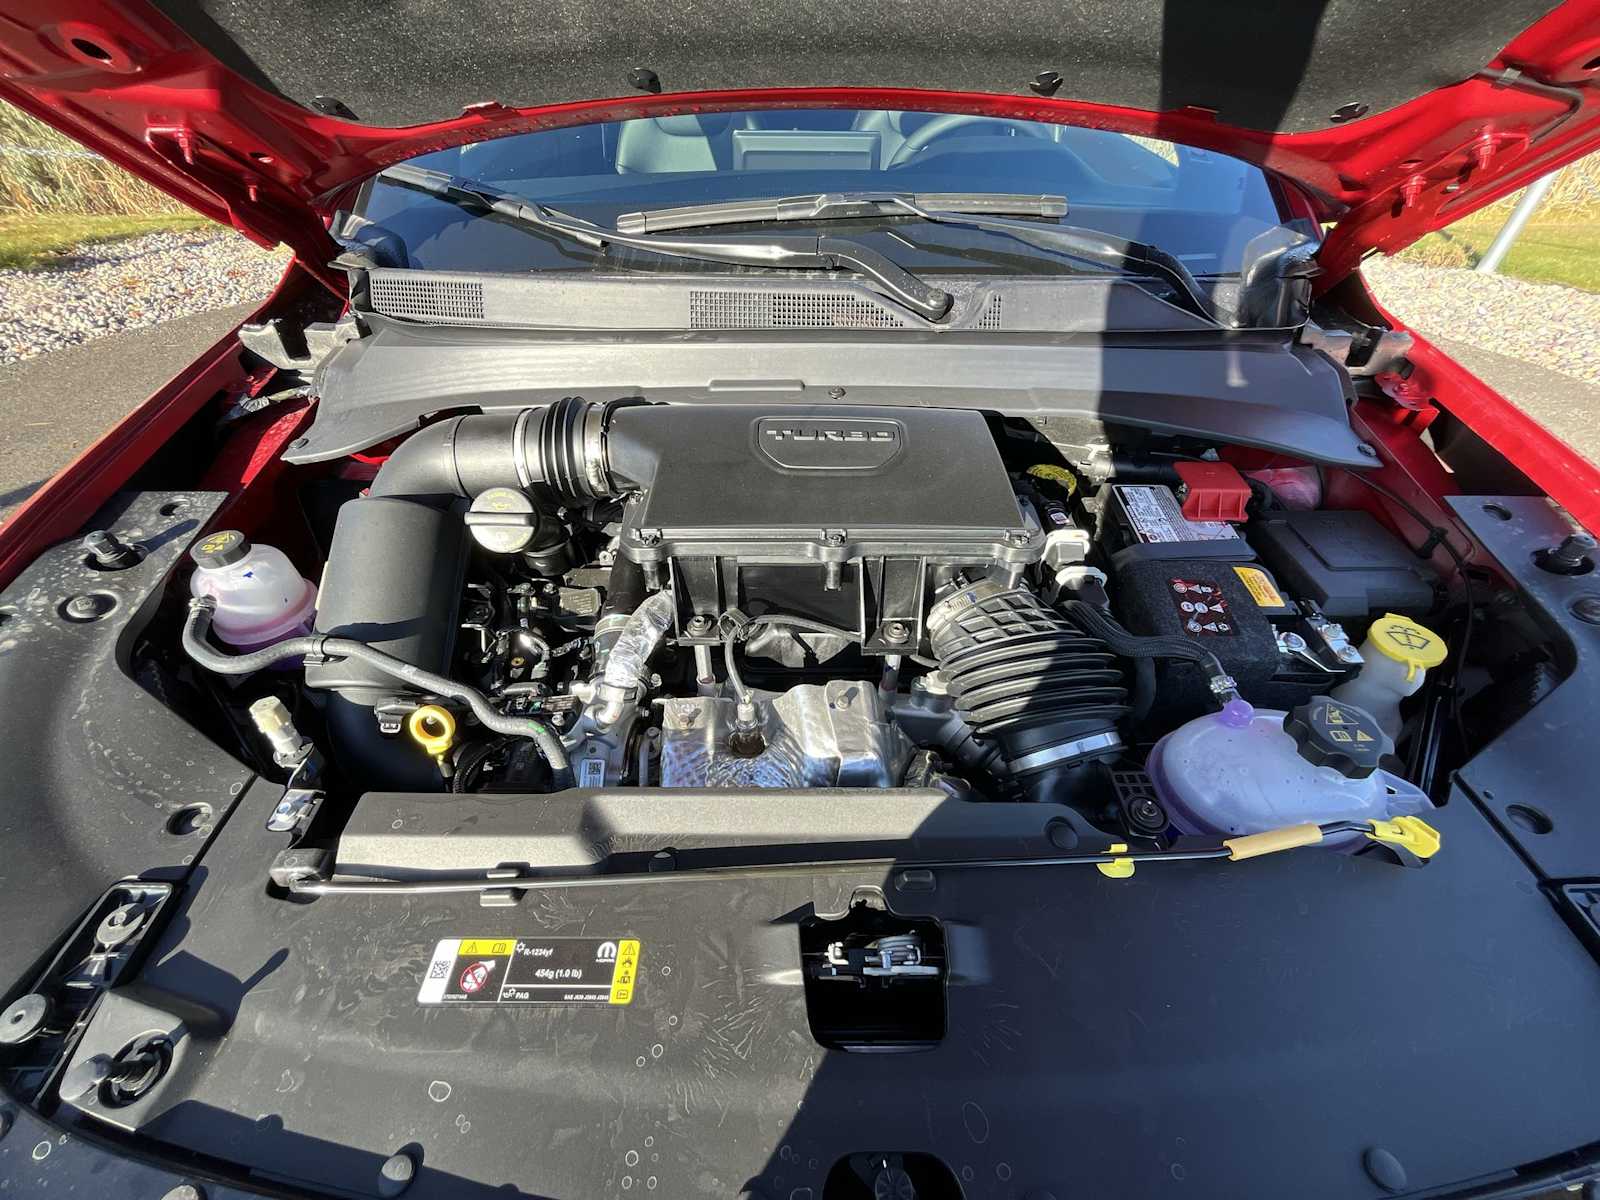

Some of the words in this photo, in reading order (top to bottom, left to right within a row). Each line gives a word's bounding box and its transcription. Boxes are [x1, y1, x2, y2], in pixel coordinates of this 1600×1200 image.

[766, 429, 895, 442] TURBO
[523, 948, 554, 957] R-1234yf
[535, 969, 554, 979] 454g
[555, 969, 569, 979] (1.0
[571, 969, 583, 979] lb)
